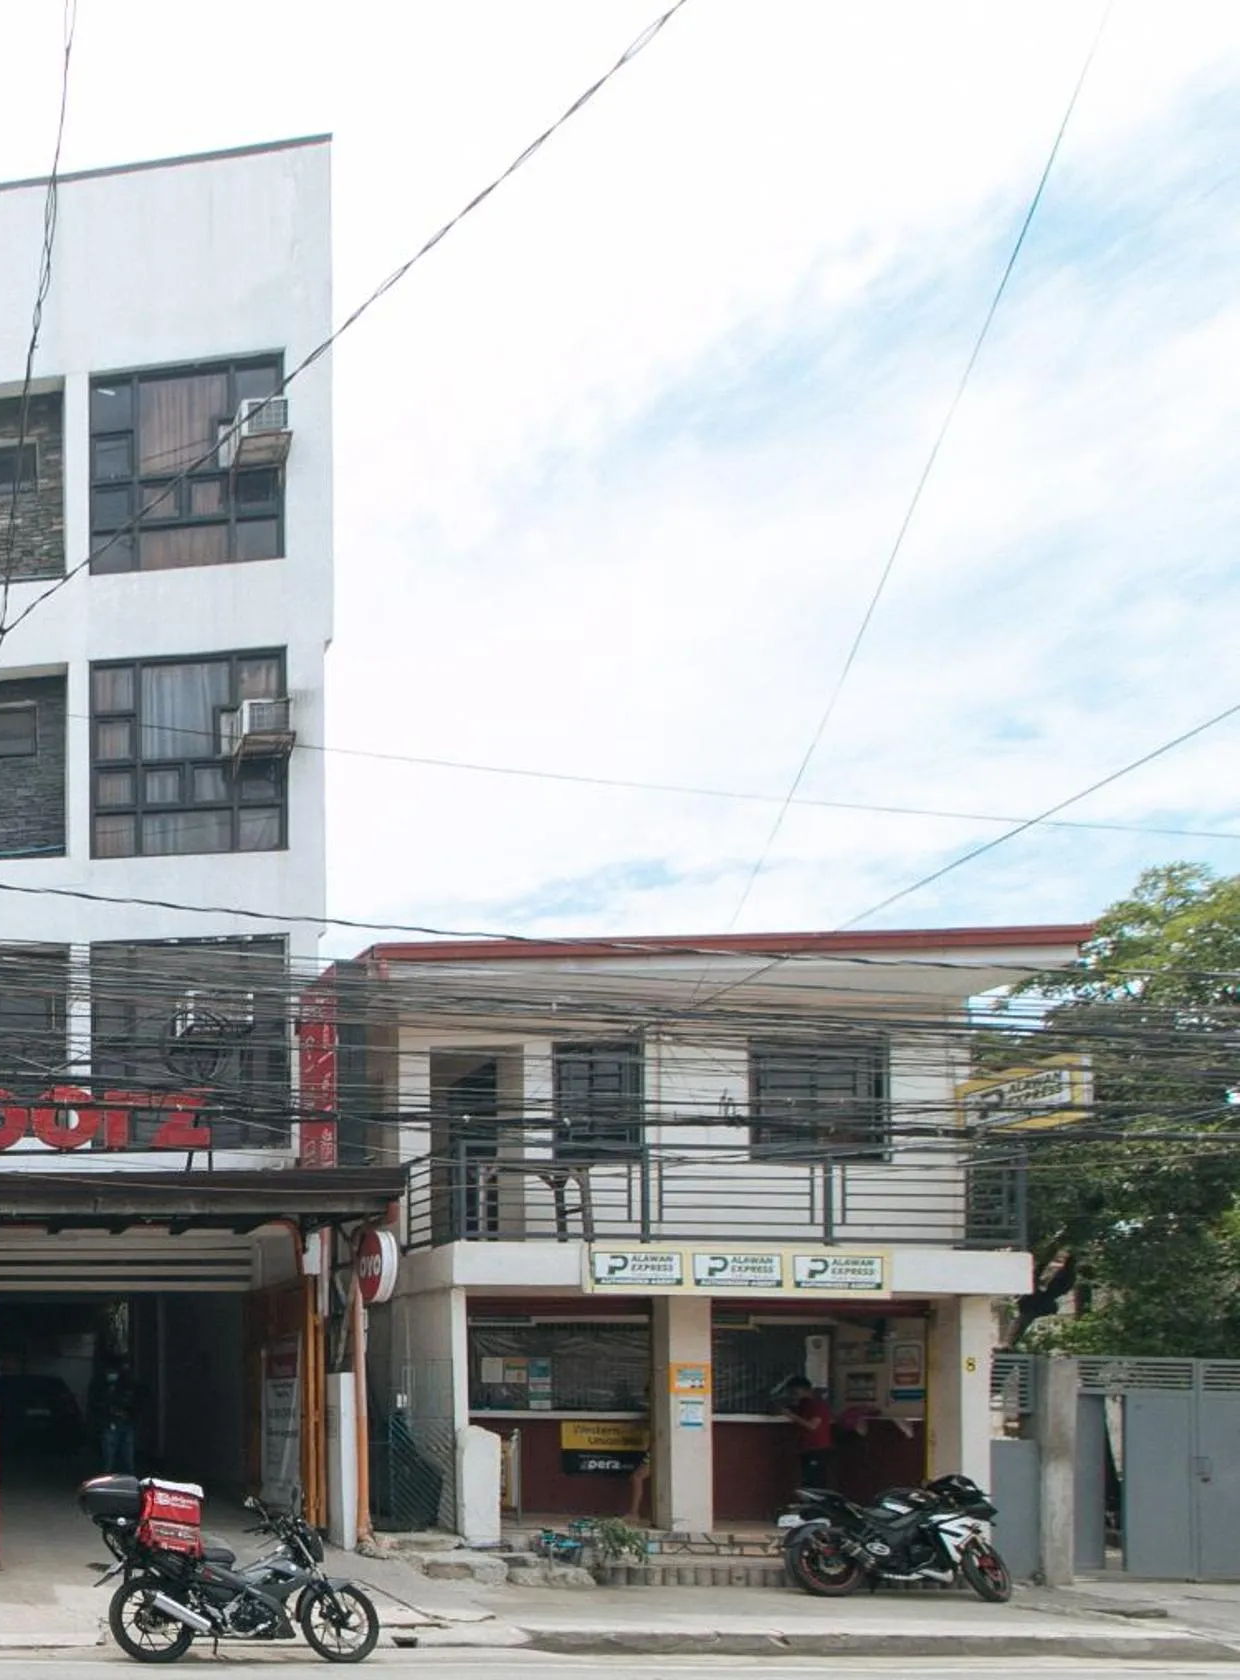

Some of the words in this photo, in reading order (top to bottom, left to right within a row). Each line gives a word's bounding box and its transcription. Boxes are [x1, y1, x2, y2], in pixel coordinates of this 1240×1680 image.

[359, 1254, 381, 1278] OYO
[631, 1264, 674, 1272] EXPRESS
[731, 1265, 774, 1273] EXPRESS
[965, 1356, 976, 1372] 8
